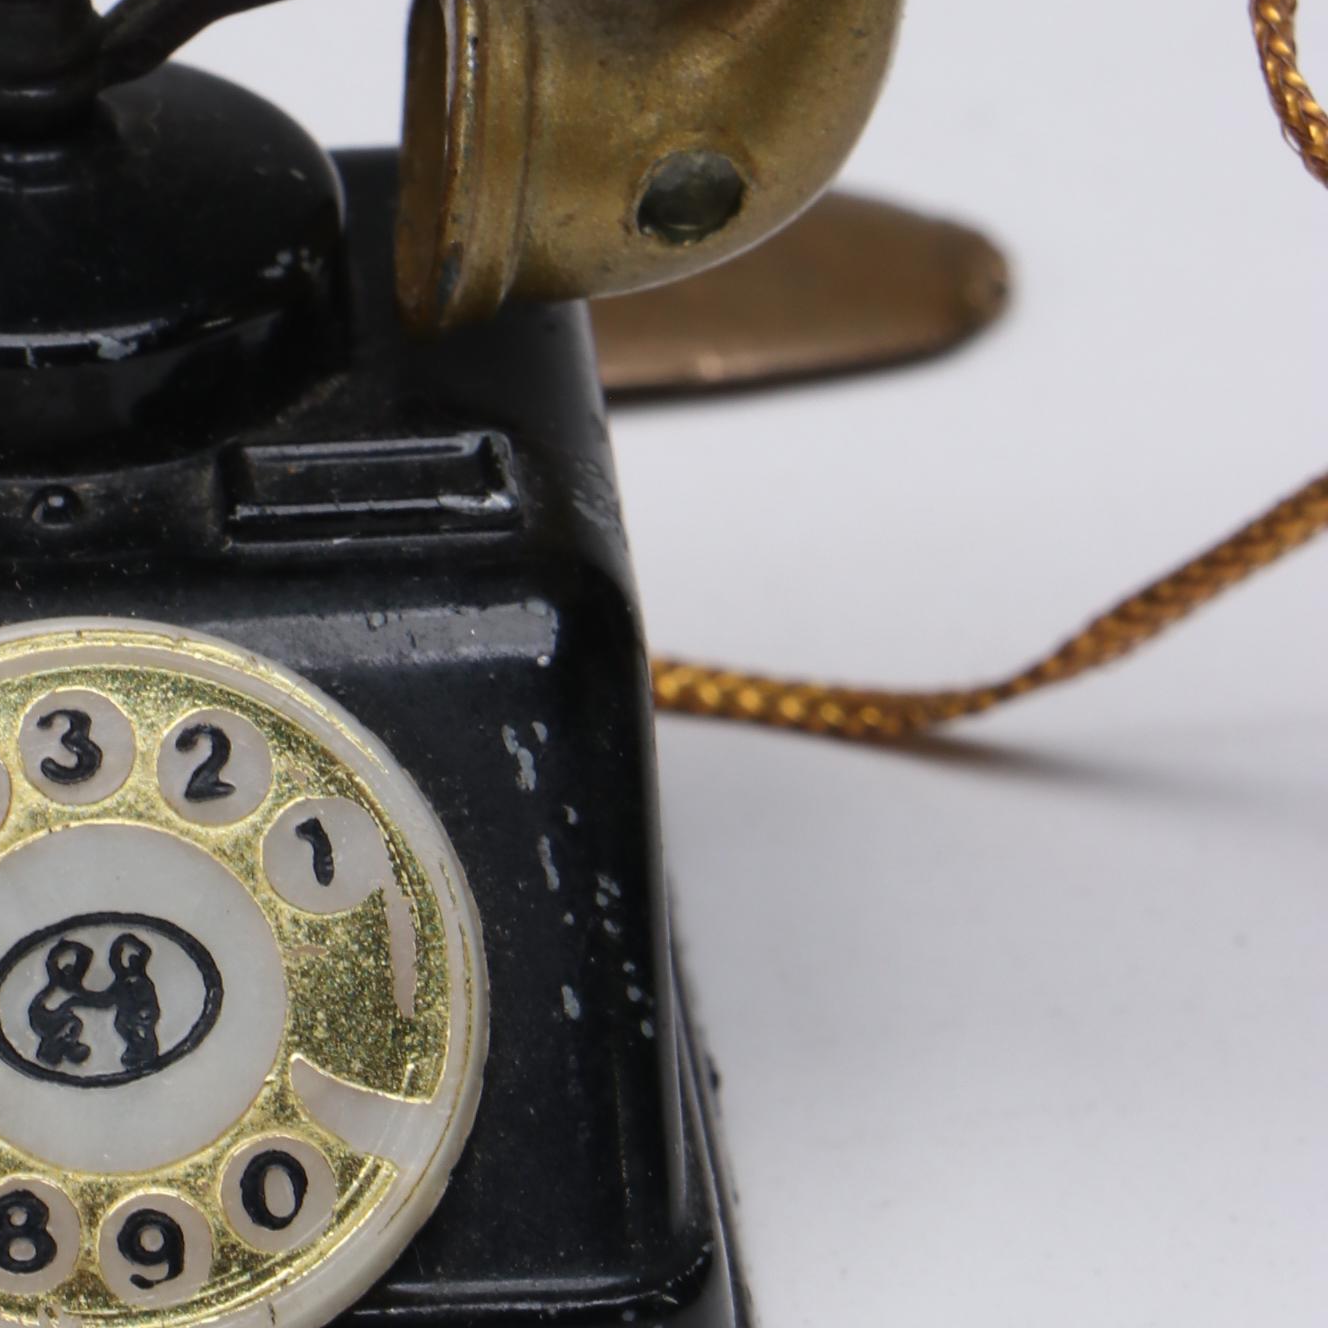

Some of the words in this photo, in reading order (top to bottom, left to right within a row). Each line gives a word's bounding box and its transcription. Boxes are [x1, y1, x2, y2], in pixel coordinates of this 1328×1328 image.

[36, 708, 103, 786] 3
[175, 723, 235, 804] 2
[295, 816, 335, 887] 1
[239, 1148, 309, 1232] 0
[116, 1208, 187, 1290] 9
